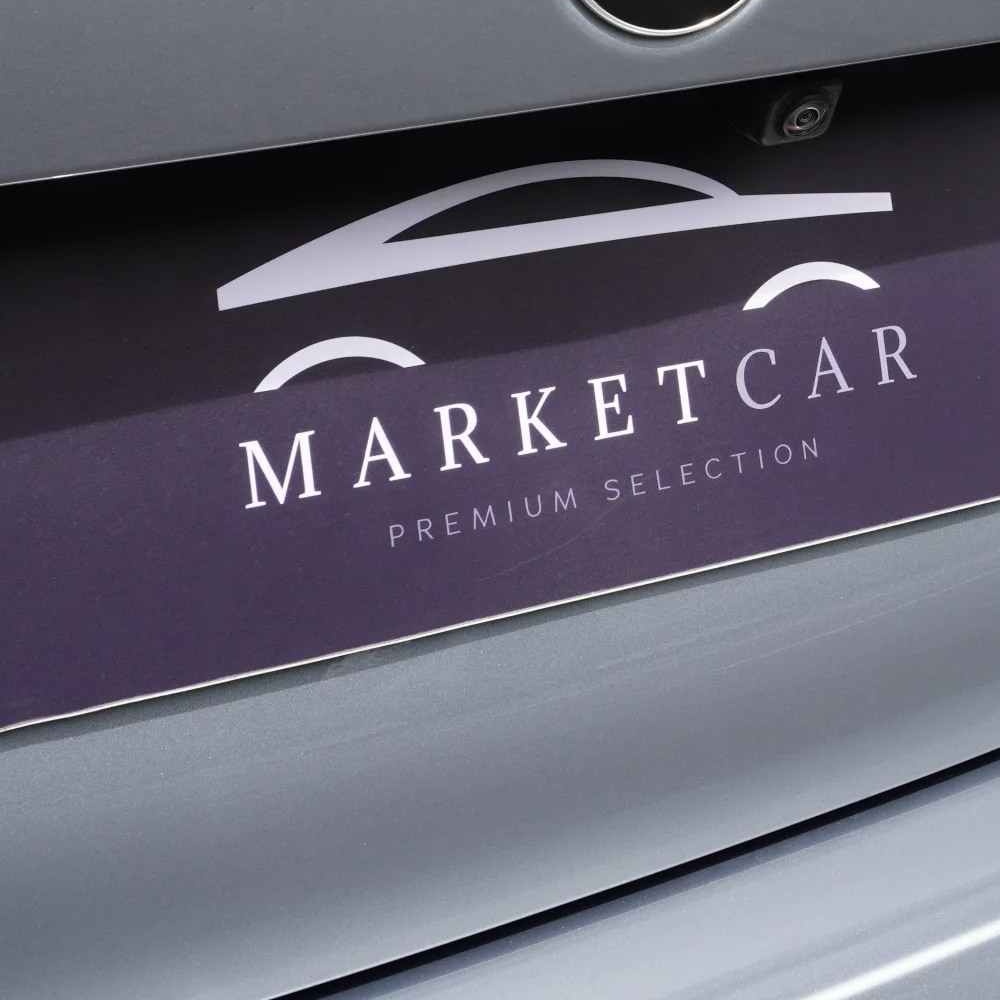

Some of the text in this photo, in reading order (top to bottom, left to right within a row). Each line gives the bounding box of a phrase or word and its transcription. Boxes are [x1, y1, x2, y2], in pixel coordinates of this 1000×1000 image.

[238, 325, 918, 509] MARKETCAR
[388, 437, 822, 548] PREMIUM SELECTION
